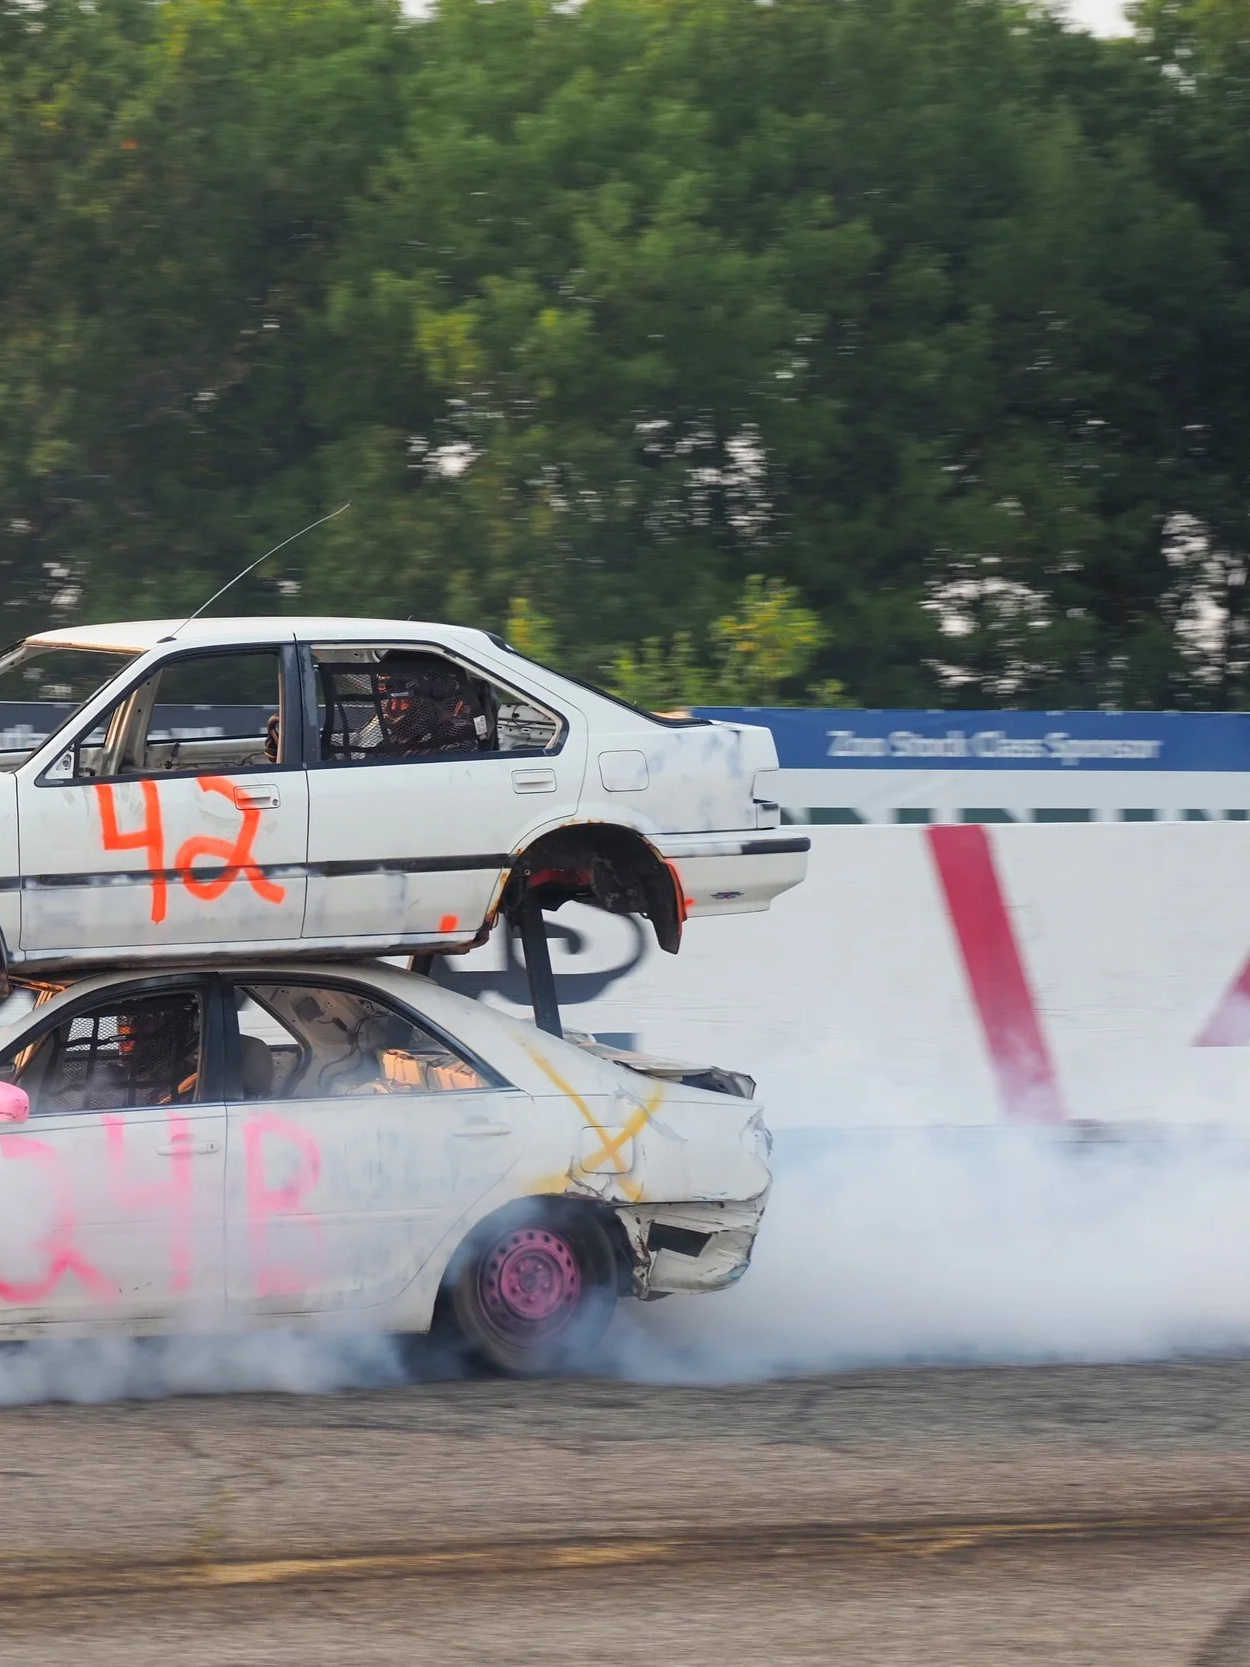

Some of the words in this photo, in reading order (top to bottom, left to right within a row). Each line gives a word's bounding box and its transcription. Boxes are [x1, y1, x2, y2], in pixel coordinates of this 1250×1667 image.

[971, 730, 1045, 759] Class
[1044, 732, 1164, 766] Sponsor
[94, 774, 285, 925] 42
